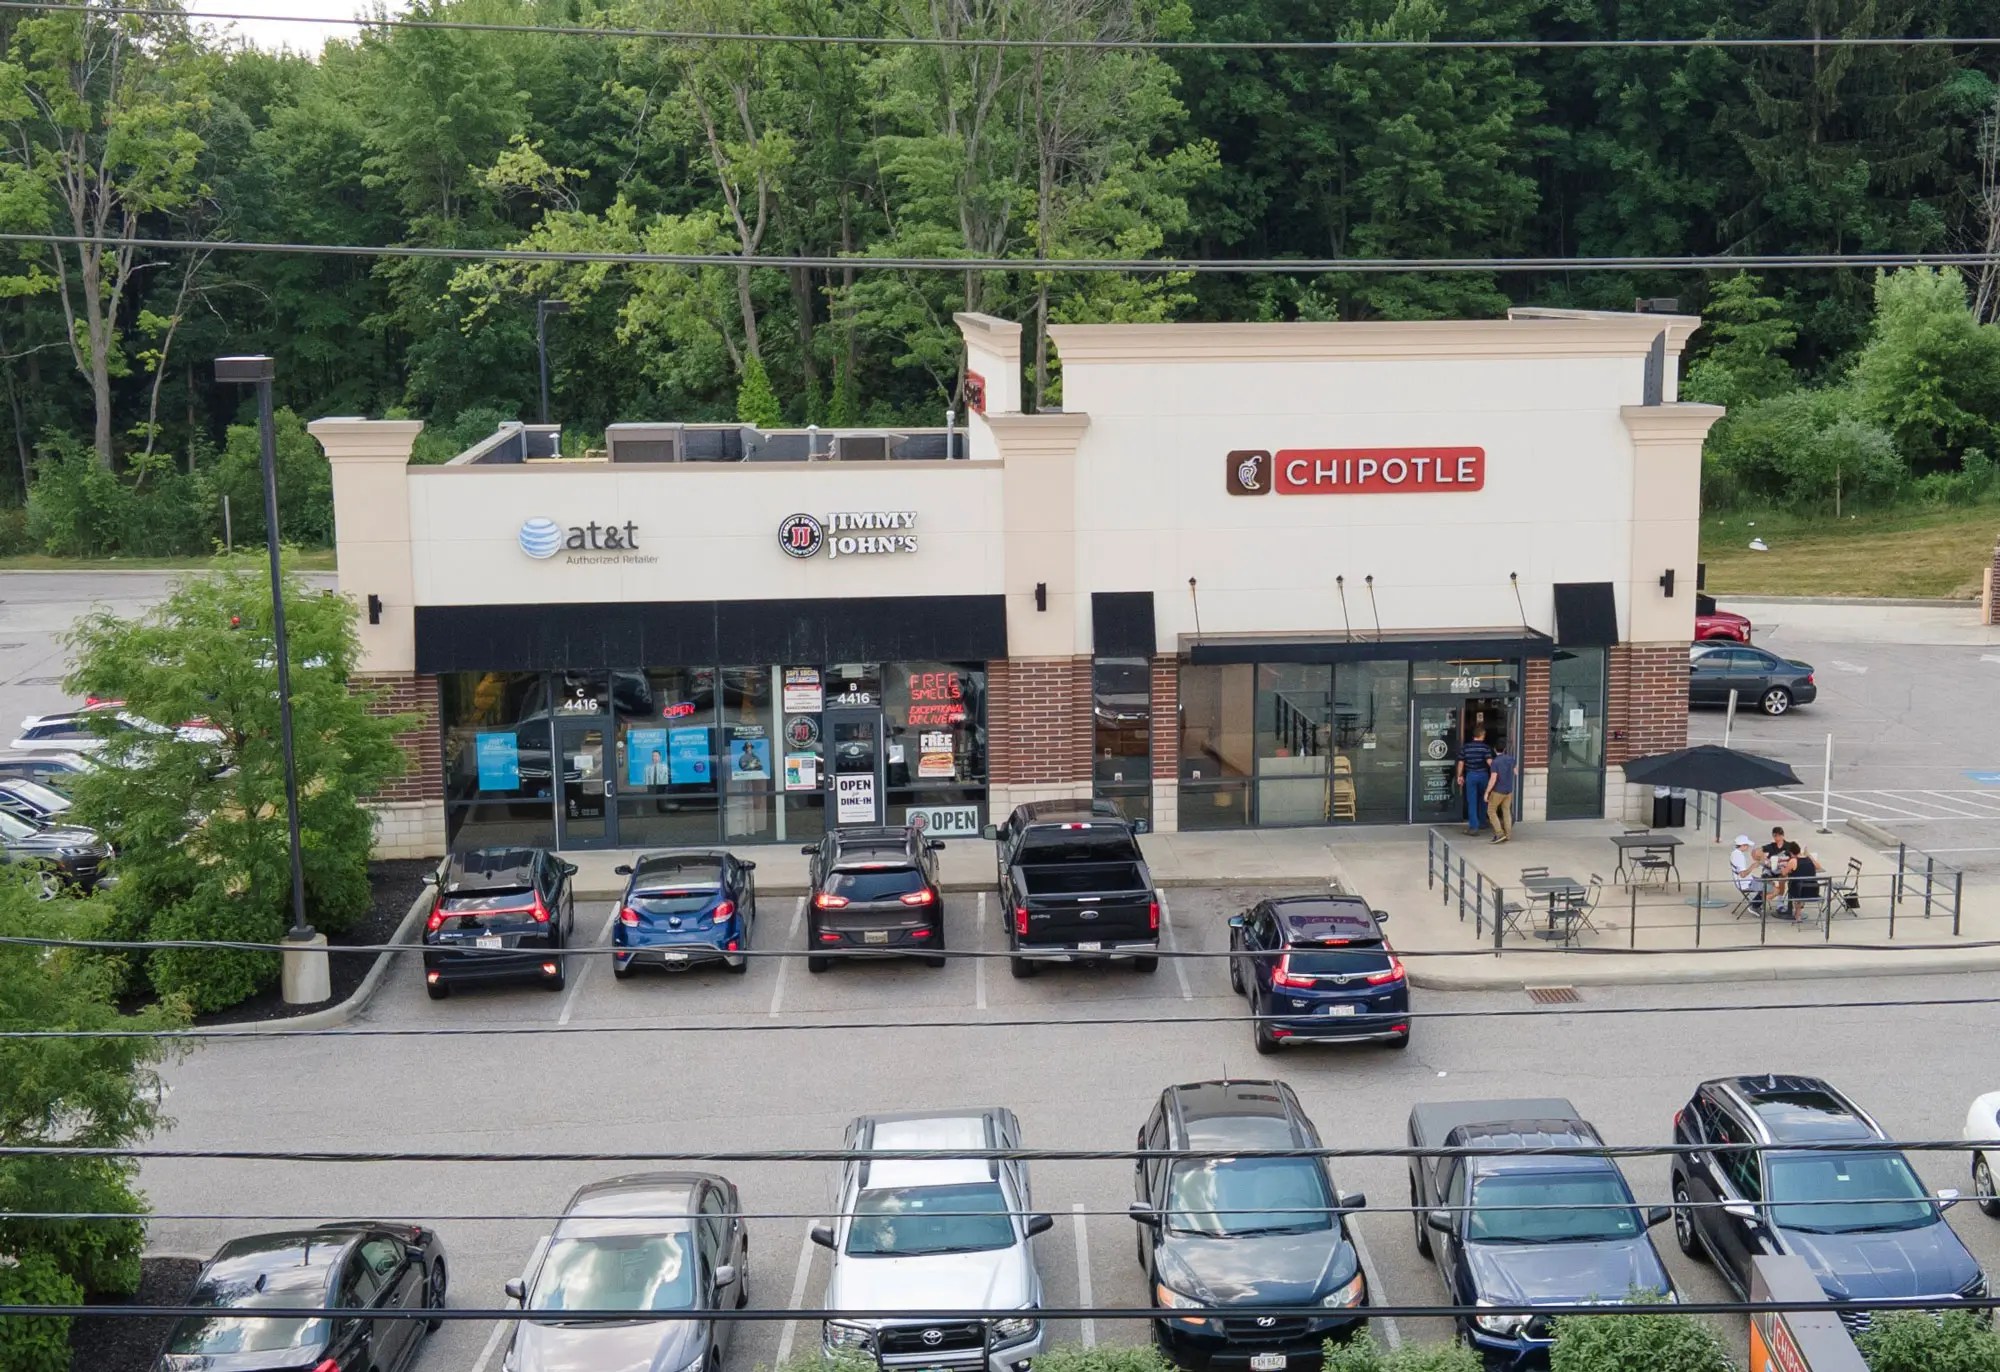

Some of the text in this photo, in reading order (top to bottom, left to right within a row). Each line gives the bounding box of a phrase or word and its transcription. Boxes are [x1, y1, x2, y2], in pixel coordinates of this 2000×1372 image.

[1286, 457, 1476, 485] CHIPOTLE
[828, 511, 917, 535] JIMMY
[566, 520, 639, 550] at&t
[791, 526, 811, 547] JJ
[828, 535, 918, 559] JOHN'S
[566, 555, 659, 565] Authorized Retailer
[1462, 667, 1470, 675] A
[849, 682, 858, 691] B
[910, 672, 959, 689] FREE
[1450, 677, 1480, 688] 4416
[576, 688, 585, 697] C
[837, 692, 870, 704] 4416
[911, 686, 961, 700] SMELLS
[564, 699, 598, 710] 4416
[663, 703, 696, 717] OPEN
[909, 704, 964, 715] EXCEPTIONAL
[908, 713, 966, 725] DELIVERY
[920, 733, 953, 747] FREE
[840, 779, 871, 791] OPEN
[841, 797, 872, 806] DINE-IN
[932, 810, 976, 830] OPEN
